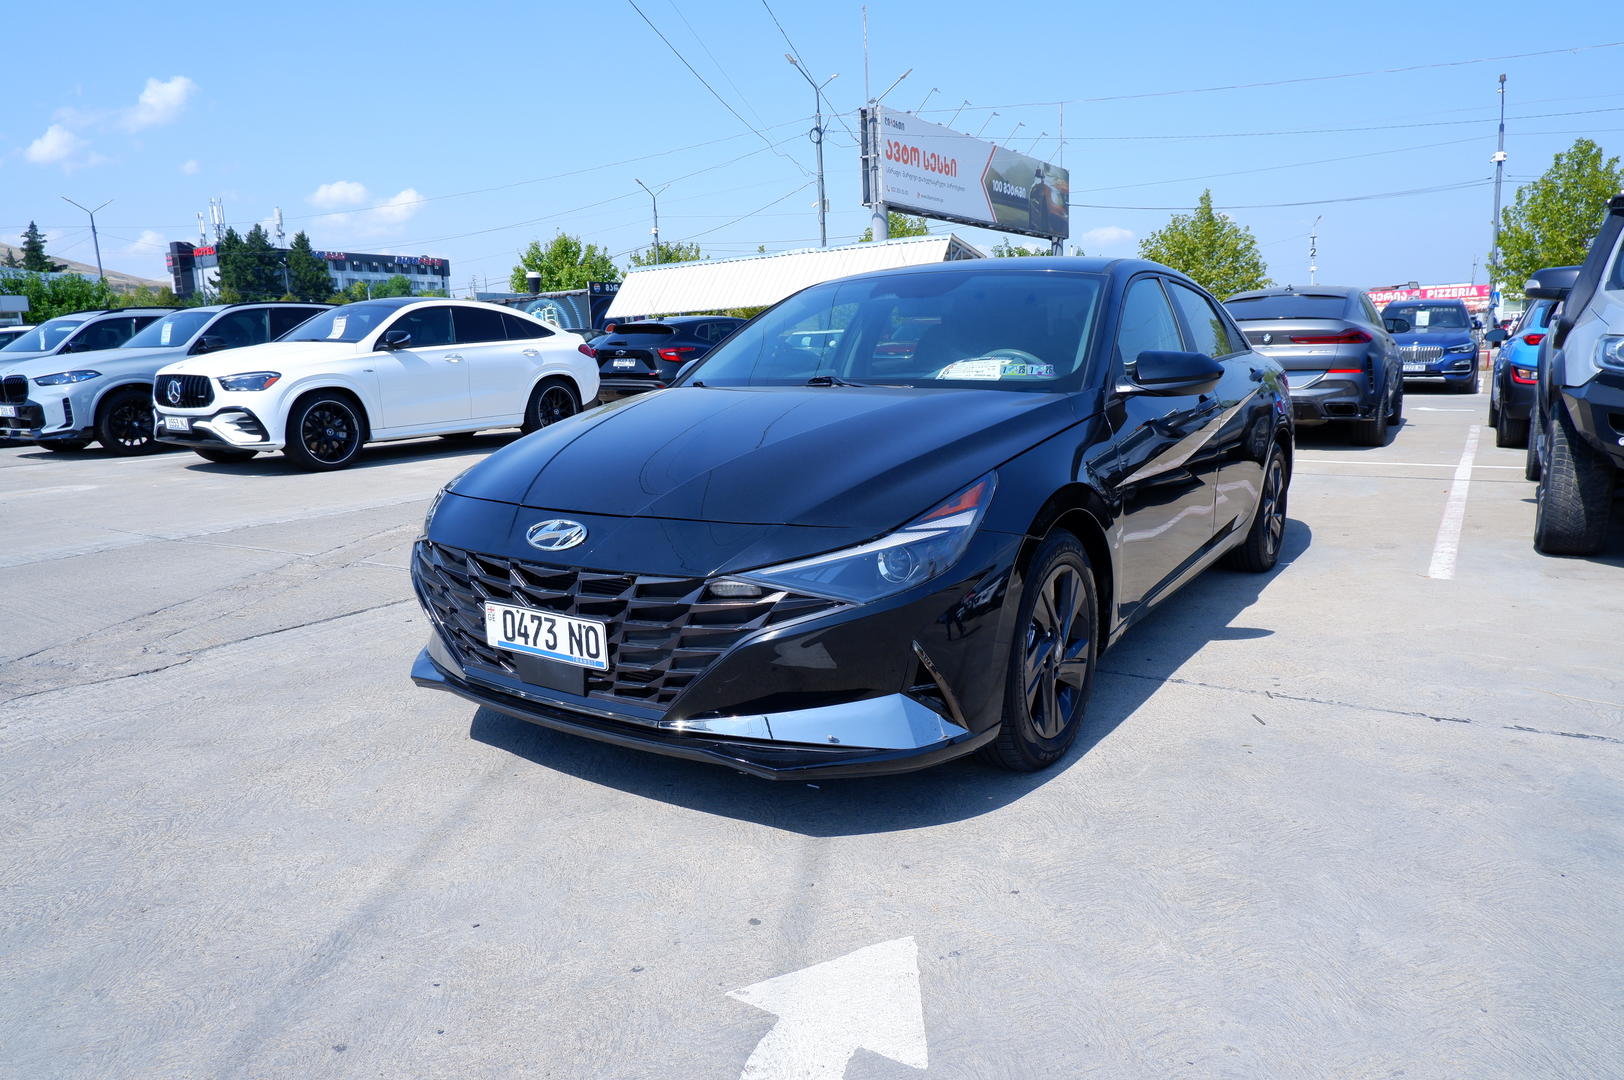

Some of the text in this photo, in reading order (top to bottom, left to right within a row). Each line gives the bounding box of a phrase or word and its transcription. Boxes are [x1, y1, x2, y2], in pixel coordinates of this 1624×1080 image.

[885, 139, 957, 178] ავტო სესხი
[992, 179, 1003, 193] 100
[193, 246, 217, 257] HOTEL
[1426, 287, 1478, 299] PIZZERIA
[503, 610, 600, 658] 0473 NO
